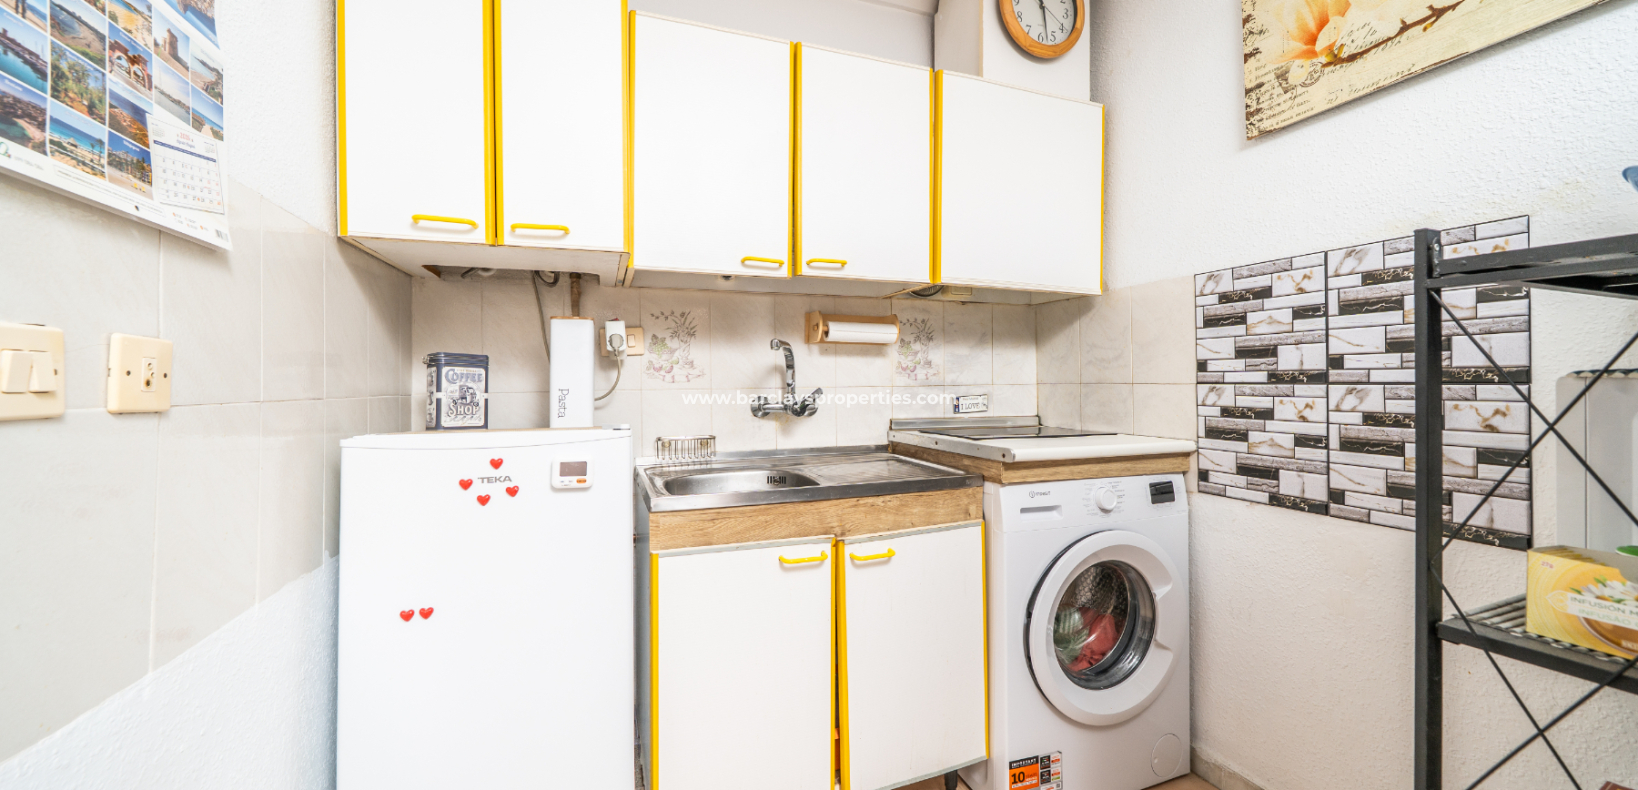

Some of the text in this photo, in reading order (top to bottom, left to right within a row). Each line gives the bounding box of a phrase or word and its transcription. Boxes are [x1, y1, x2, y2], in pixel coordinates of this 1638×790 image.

[1016, 10, 1022, 22] 8
[1062, 8, 1068, 19] 3
[1025, 24, 1031, 35] 7
[1058, 22, 1064, 33] 4
[1037, 32, 1043, 43] 6
[1049, 31, 1056, 42] 5
[445, 368, 483, 384] COFFEE
[557, 388, 570, 418] Pasta
[448, 403, 480, 417] SHOP
[477, 475, 512, 484] TEKA
[1011, 771, 1026, 785] 10
